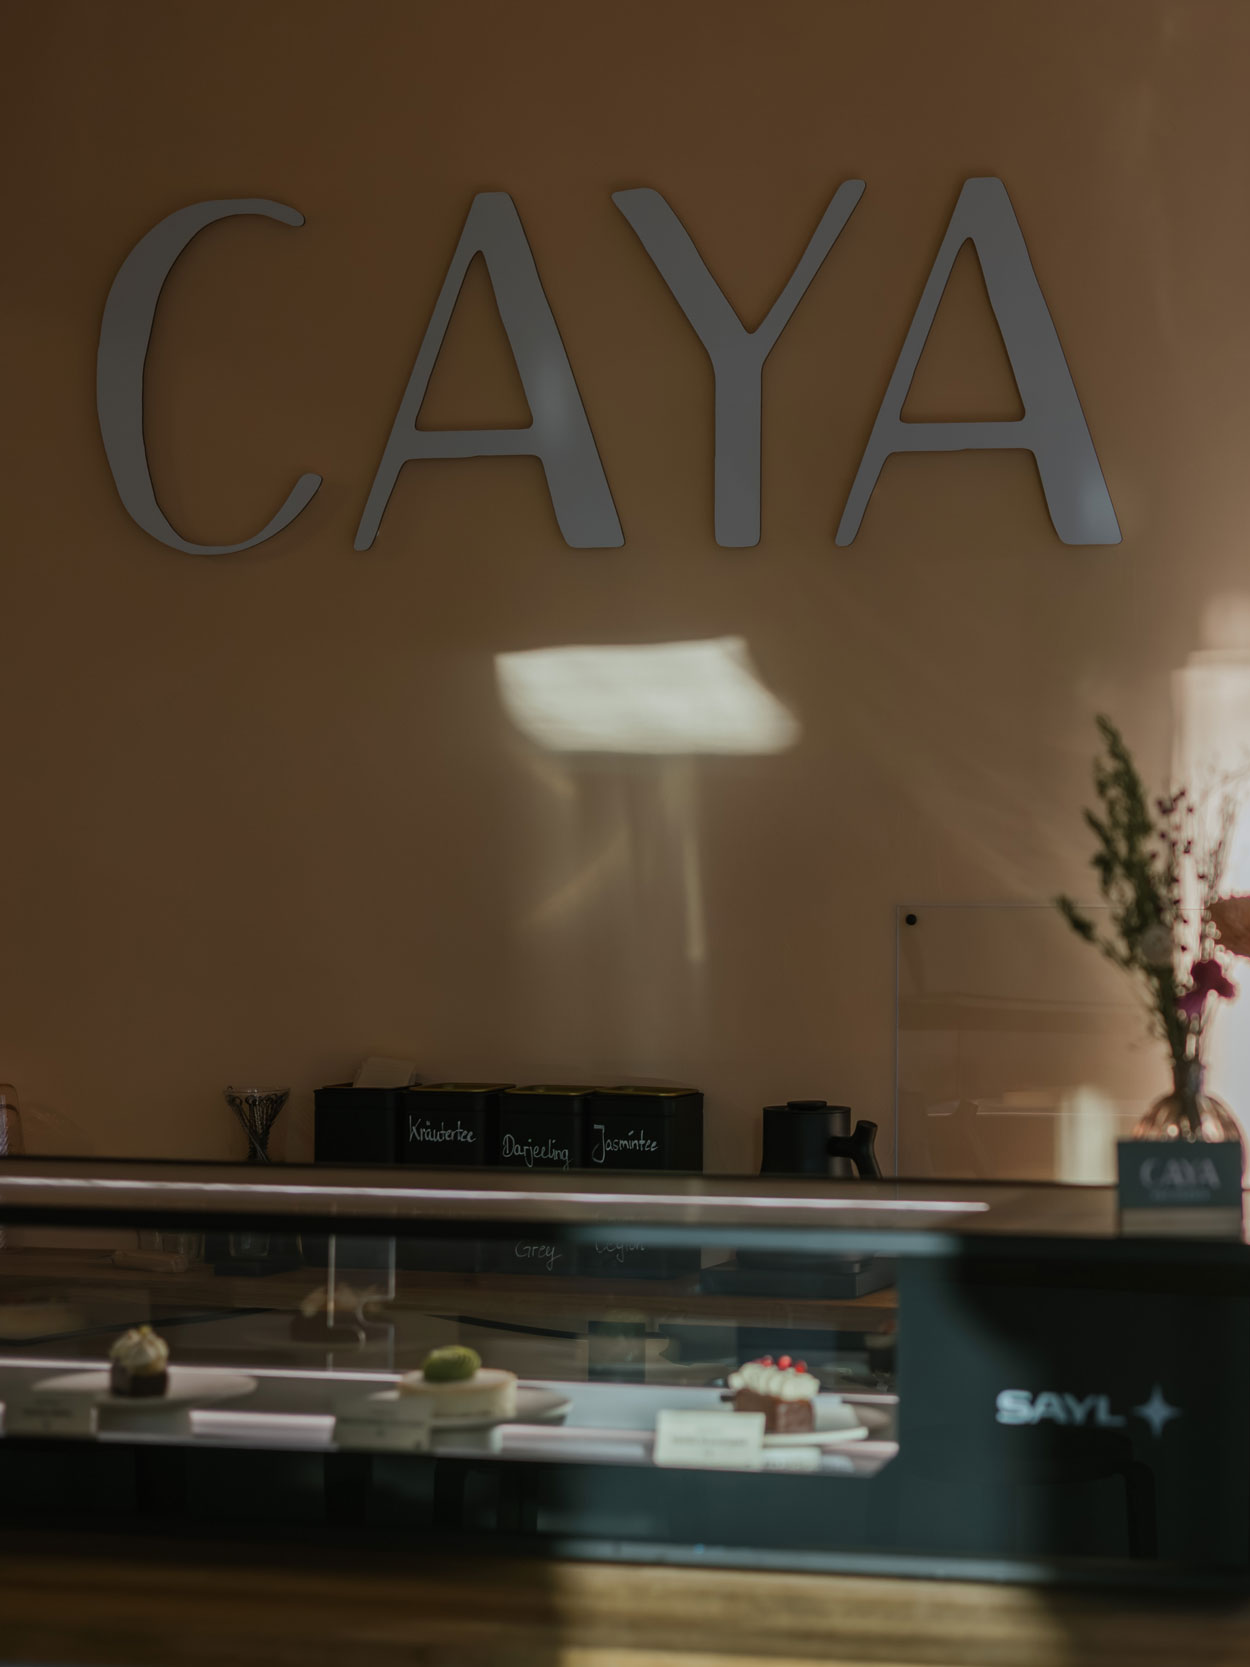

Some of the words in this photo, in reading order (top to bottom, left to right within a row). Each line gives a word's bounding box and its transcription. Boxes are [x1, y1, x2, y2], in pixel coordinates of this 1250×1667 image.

[96, 176, 1123, 556] CAYA
[408, 1115, 477, 1144] Kräutertee
[591, 1124, 660, 1164] Jasmintee
[502, 1133, 572, 1170] Darjeeling
[514, 1240, 563, 1272] Grey
[995, 1388, 1127, 1428] SAYL
